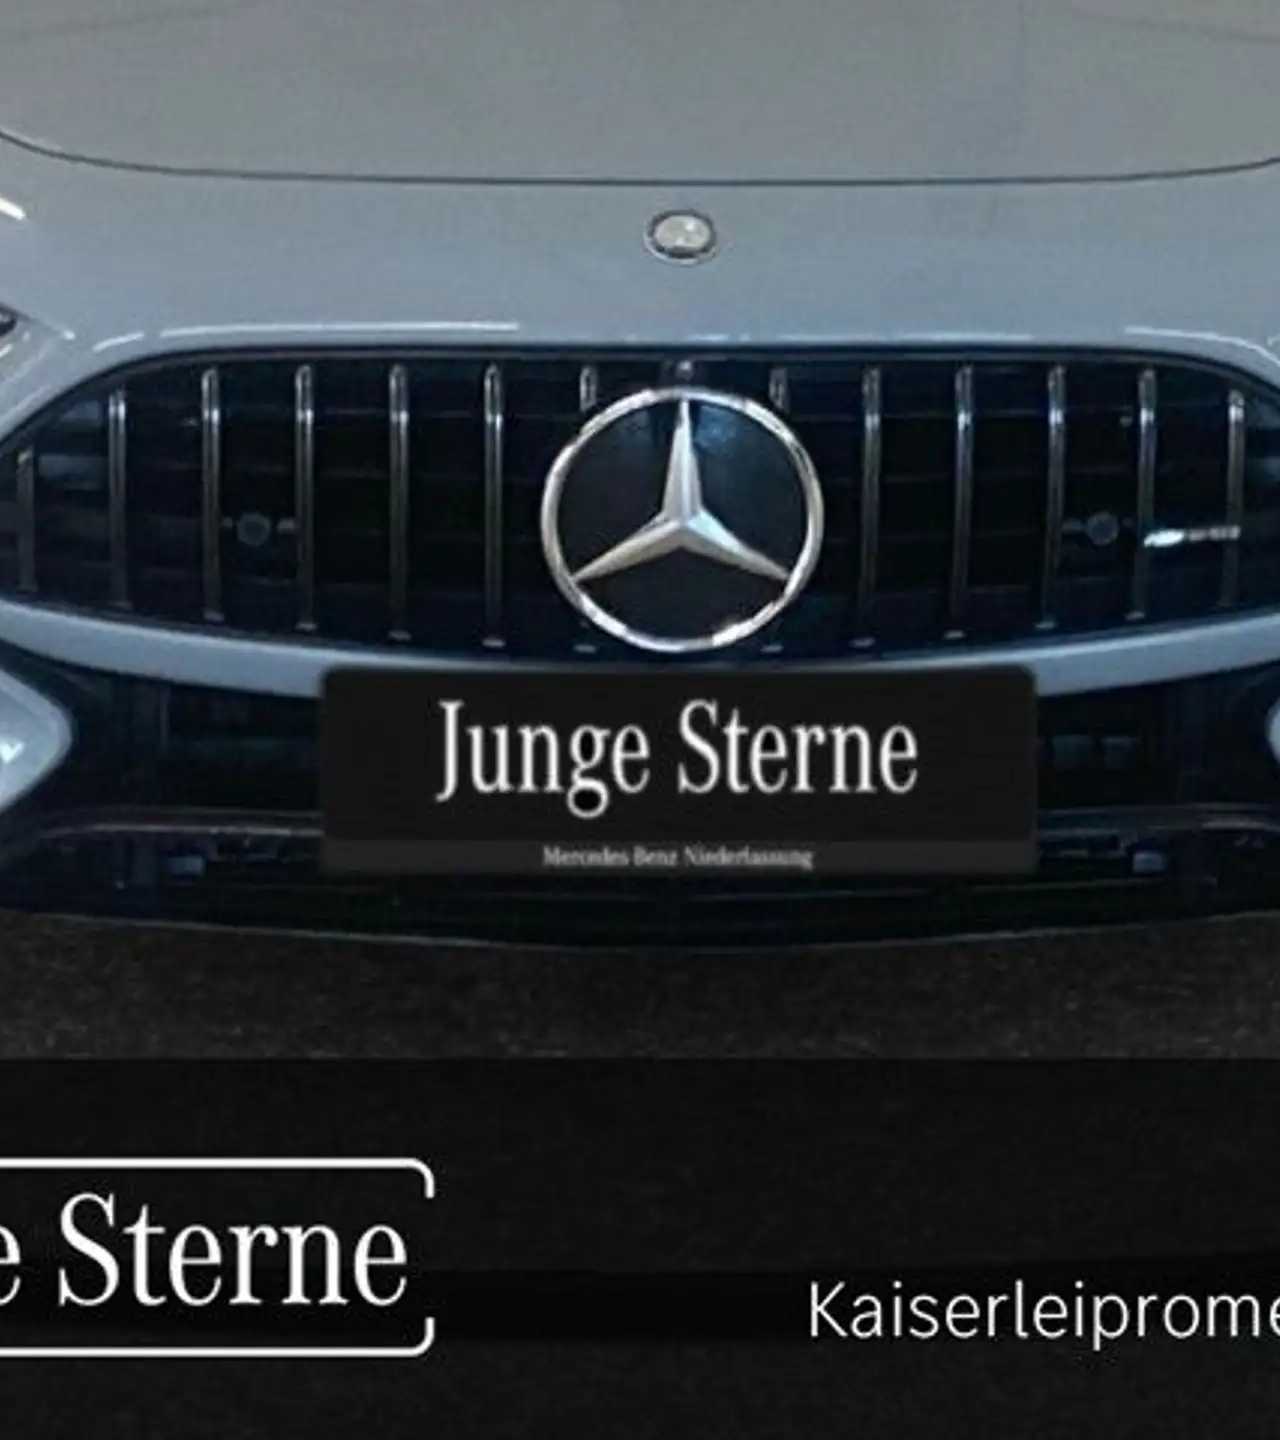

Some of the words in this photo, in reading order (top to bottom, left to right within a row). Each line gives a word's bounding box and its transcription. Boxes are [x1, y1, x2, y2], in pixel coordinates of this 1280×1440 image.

[436, 700, 650, 818] Junge
[678, 699, 918, 794] Sterne
[684, 845, 813, 870] Niederlassung
